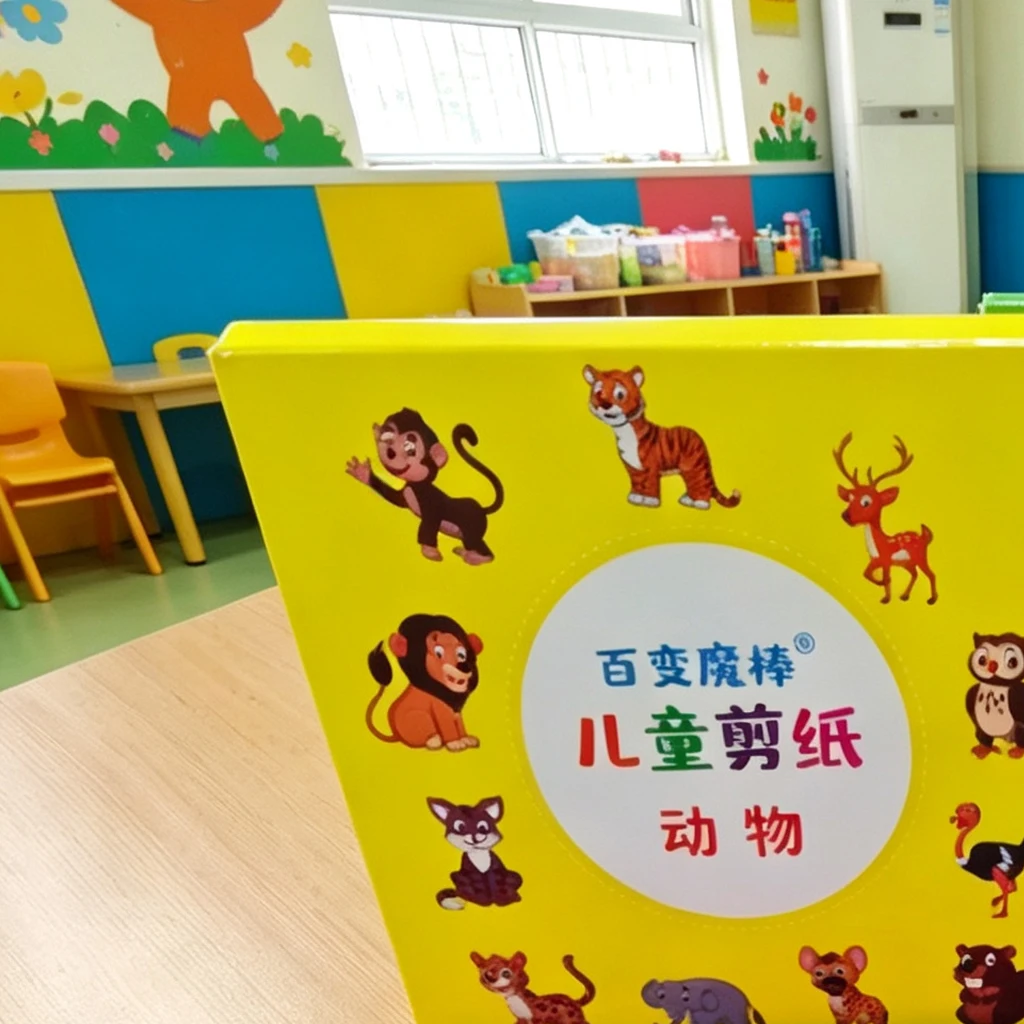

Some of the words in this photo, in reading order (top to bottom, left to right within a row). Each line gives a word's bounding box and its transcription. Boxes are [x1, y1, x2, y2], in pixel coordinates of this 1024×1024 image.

[596, 641, 796, 688] 百变魔棒
[578, 703, 863, 771] 儿童剪纸
[660, 805, 804, 857] 动物
